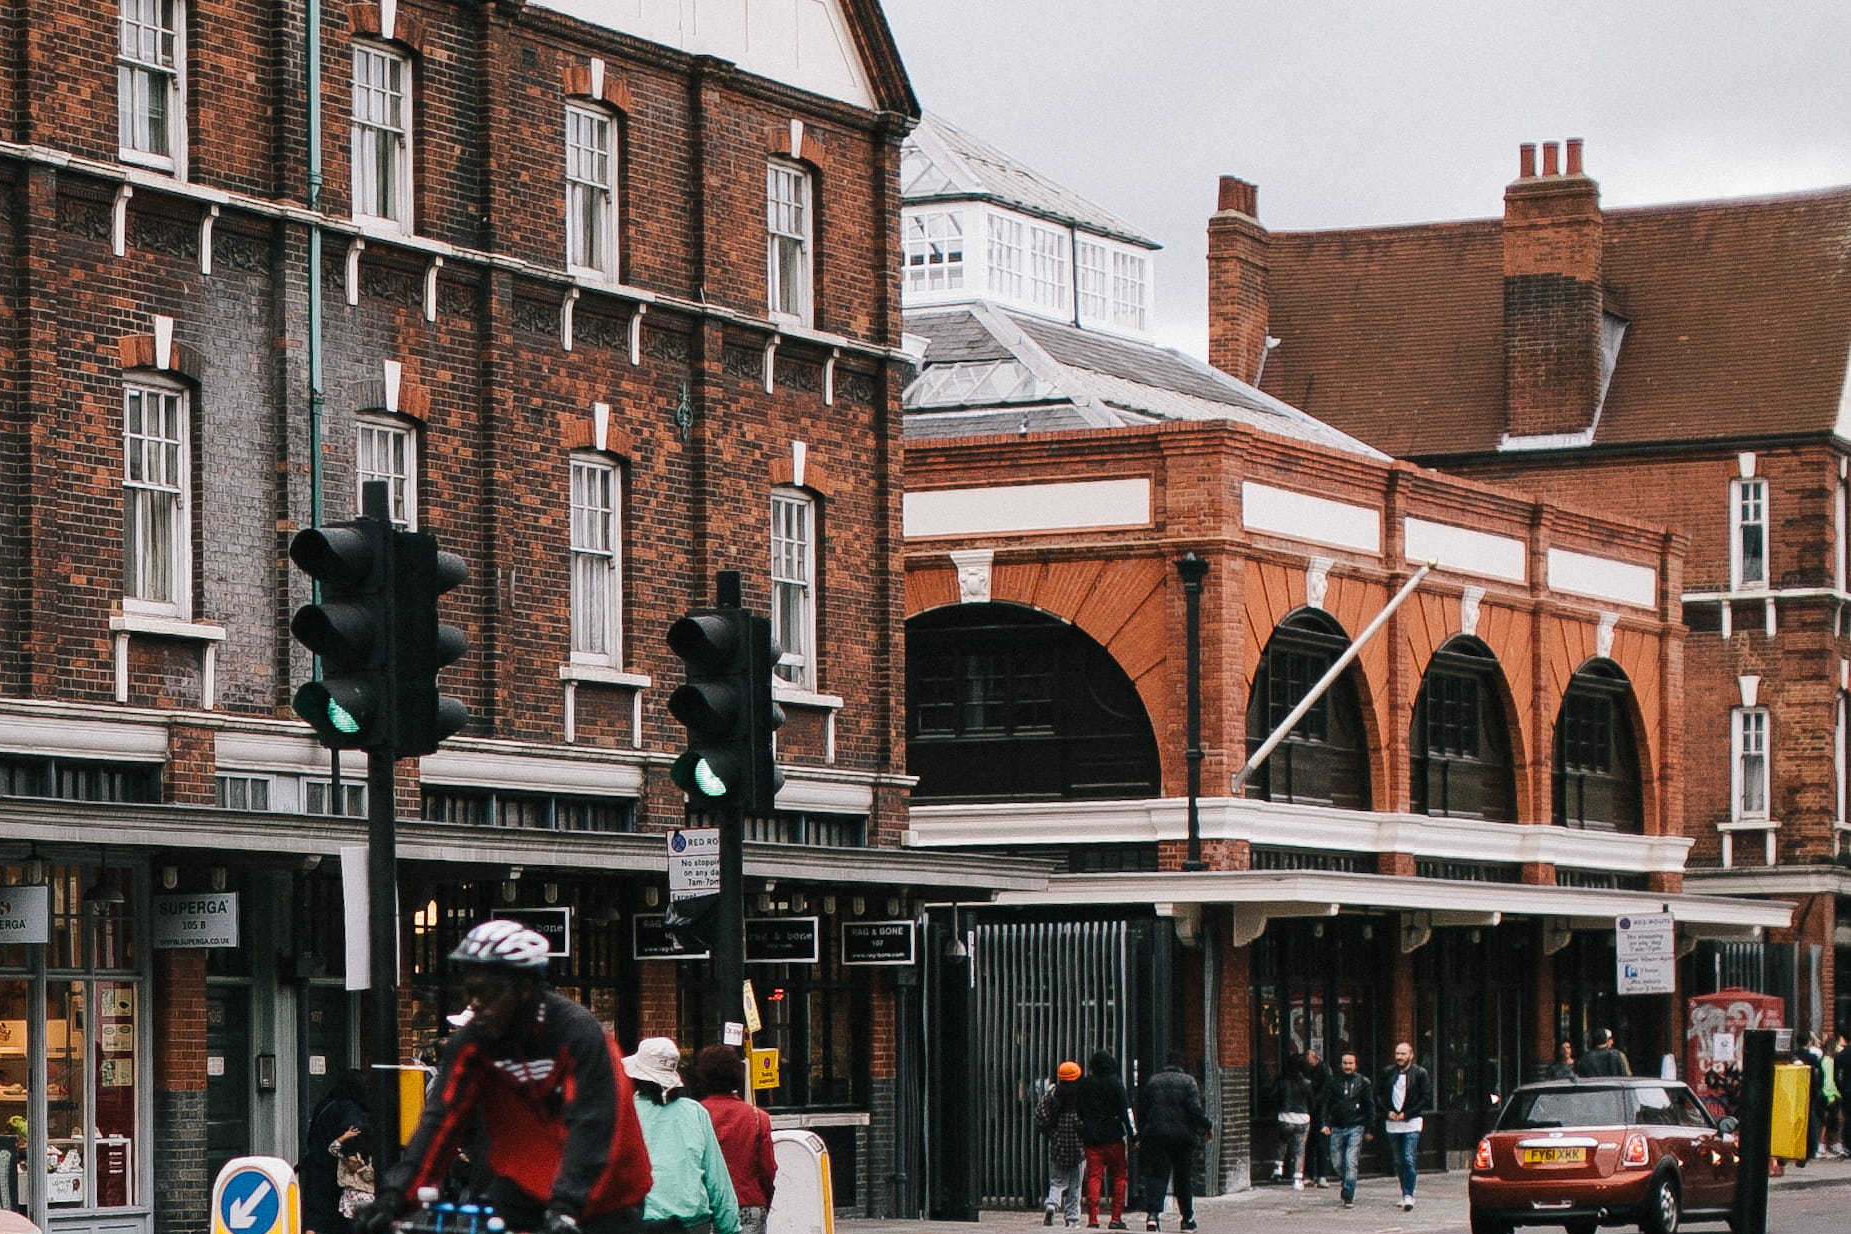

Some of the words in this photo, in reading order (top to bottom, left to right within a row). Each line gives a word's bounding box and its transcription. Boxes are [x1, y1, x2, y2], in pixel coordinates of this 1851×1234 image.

[688, 838, 705, 847] RED
[682, 858, 692, 867] No
[181, 920, 198, 930] 105
